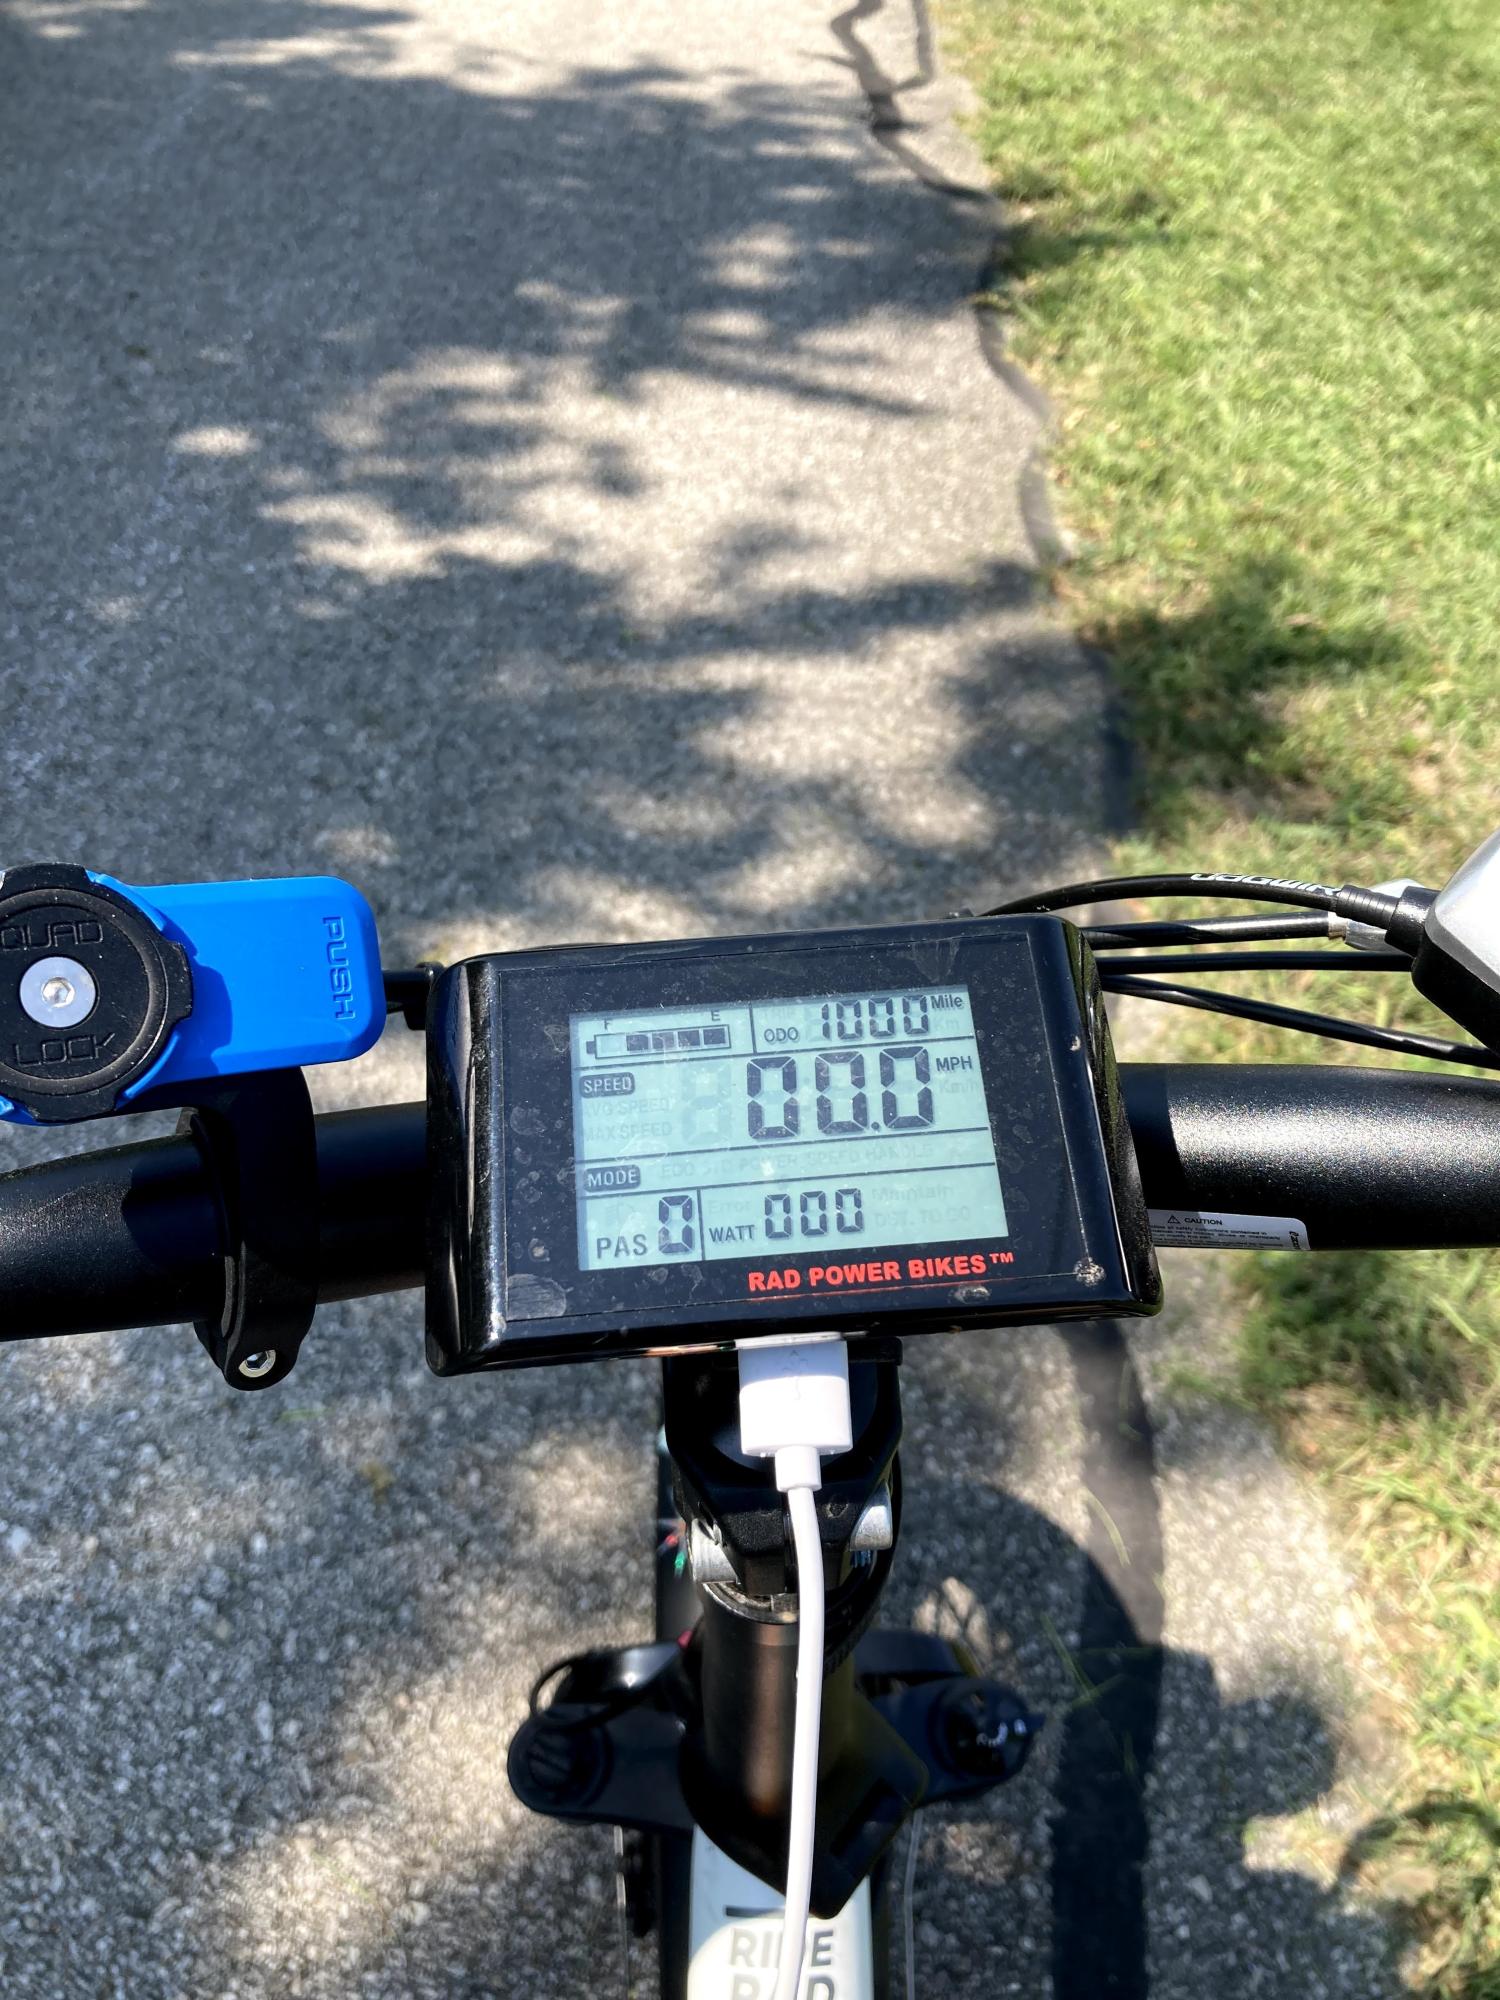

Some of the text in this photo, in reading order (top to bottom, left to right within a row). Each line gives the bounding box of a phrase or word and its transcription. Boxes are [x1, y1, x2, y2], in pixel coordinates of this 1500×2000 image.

[1190, 873, 1341, 896] JAGWIR
[1, 922, 104, 950] QUAD
[322, 916, 356, 1019] PUSH
[711, 1010, 721, 1021] E
[764, 994, 963, 1042] ODO 1000 Mile
[15, 1033, 116, 1066] LOCK
[583, 1076, 633, 1094] SPEED
[747, 1046, 973, 1140] 00.0 MPH
[586, 1170, 639, 1188] MODE
[596, 1195, 695, 1259] PAS 0
[708, 1188, 864, 1242] WATT 000
[1184, 1217, 1223, 1226] CAUTION
[748, 1269, 801, 1292] RAD
[808, 1260, 902, 1286] POWER
[908, 1254, 988, 1279] BIKES
[732, 1974, 836, 2000] RD
